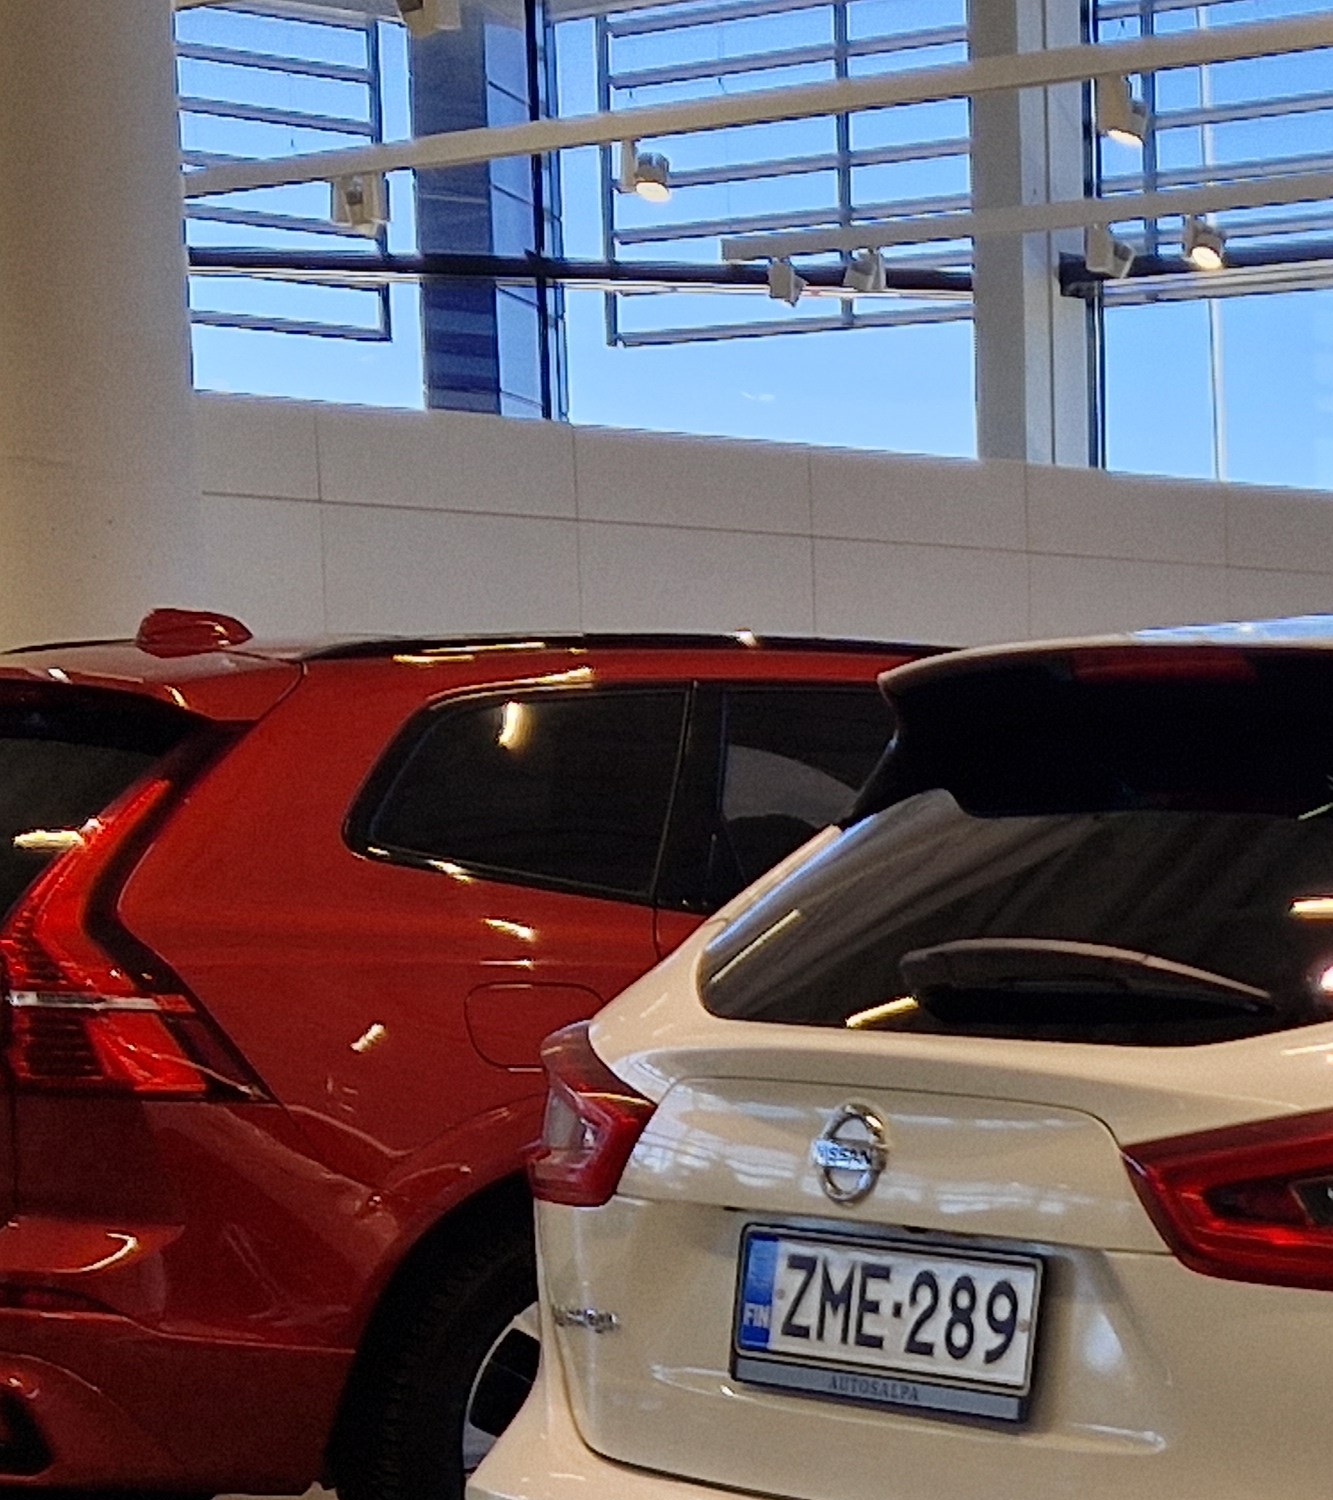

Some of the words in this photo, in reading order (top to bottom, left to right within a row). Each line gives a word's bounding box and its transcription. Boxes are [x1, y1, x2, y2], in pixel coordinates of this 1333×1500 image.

[817, 1143, 874, 1168] NISSAN
[743, 1302, 770, 1328] FIN
[779, 1252, 1020, 1366] ZME-289
[828, 1375, 920, 1402] AUTOSALPA
